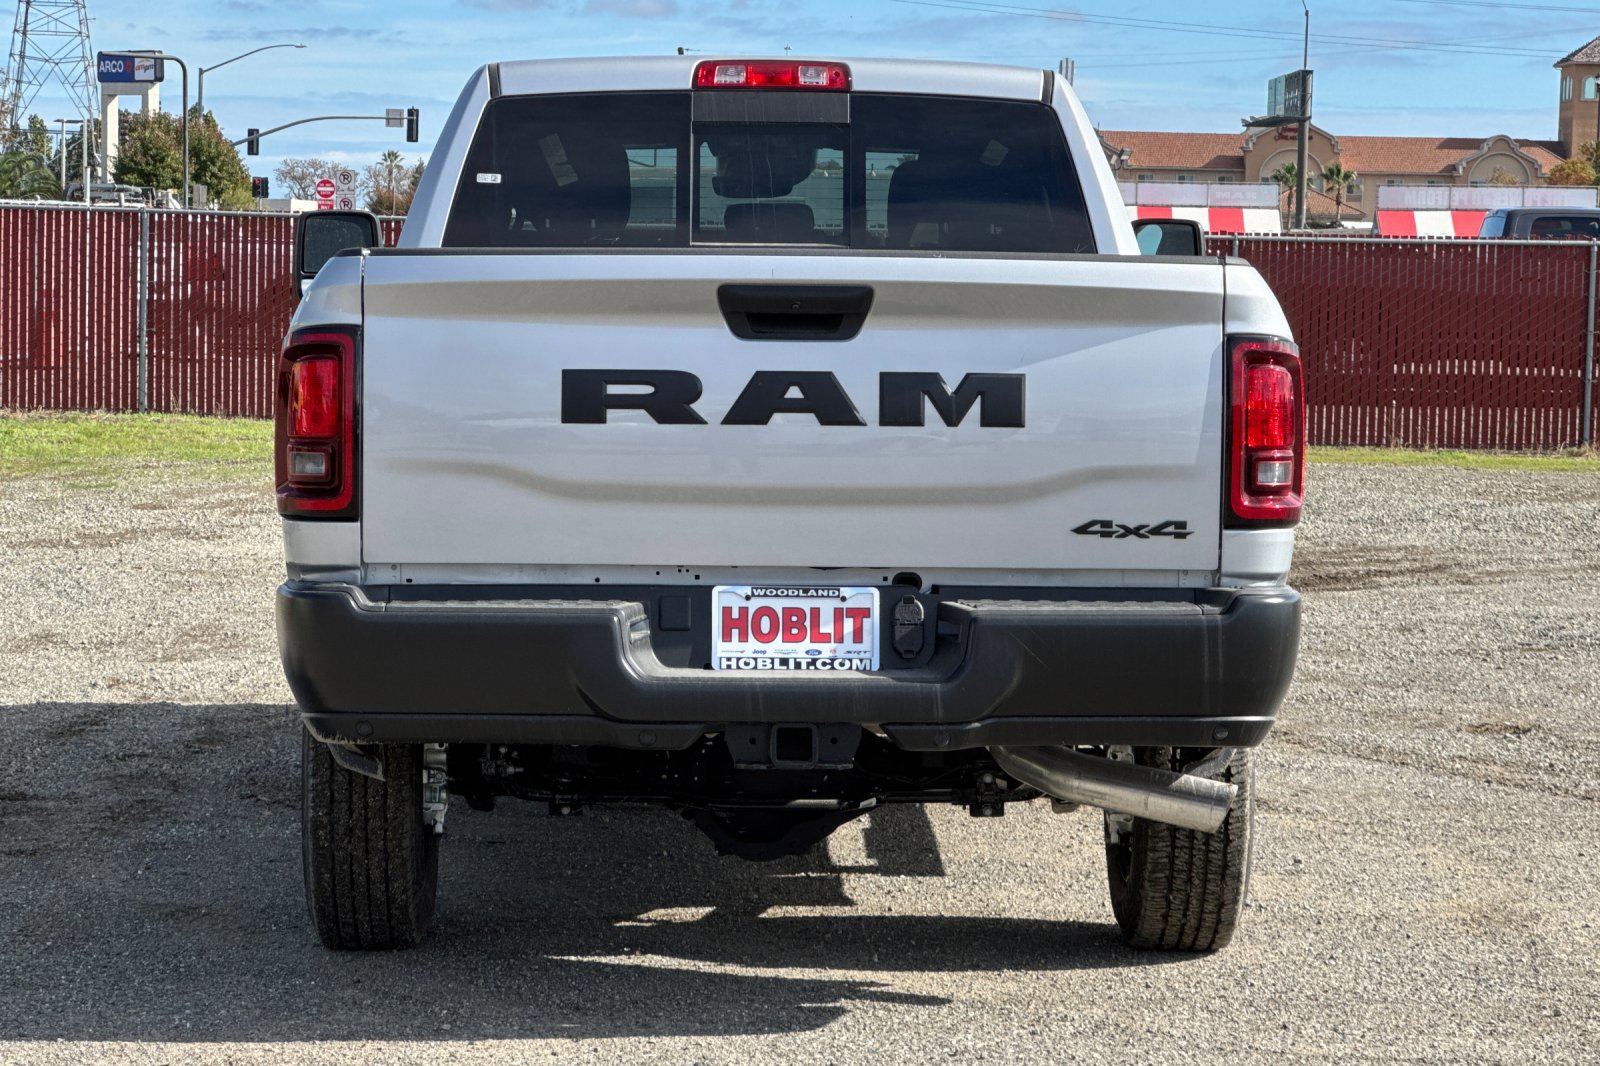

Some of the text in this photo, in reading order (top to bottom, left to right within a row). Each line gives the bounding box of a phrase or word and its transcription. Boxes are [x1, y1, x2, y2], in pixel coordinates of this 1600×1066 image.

[99, 61, 124, 73] ARCO
[561, 368, 1026, 427] RAM
[1070, 519, 1195, 539] 4x4
[752, 588, 840, 597] WOODLAND
[721, 605, 871, 644] HOBLIT
[720, 657, 871, 671] HOBLIT.COM
